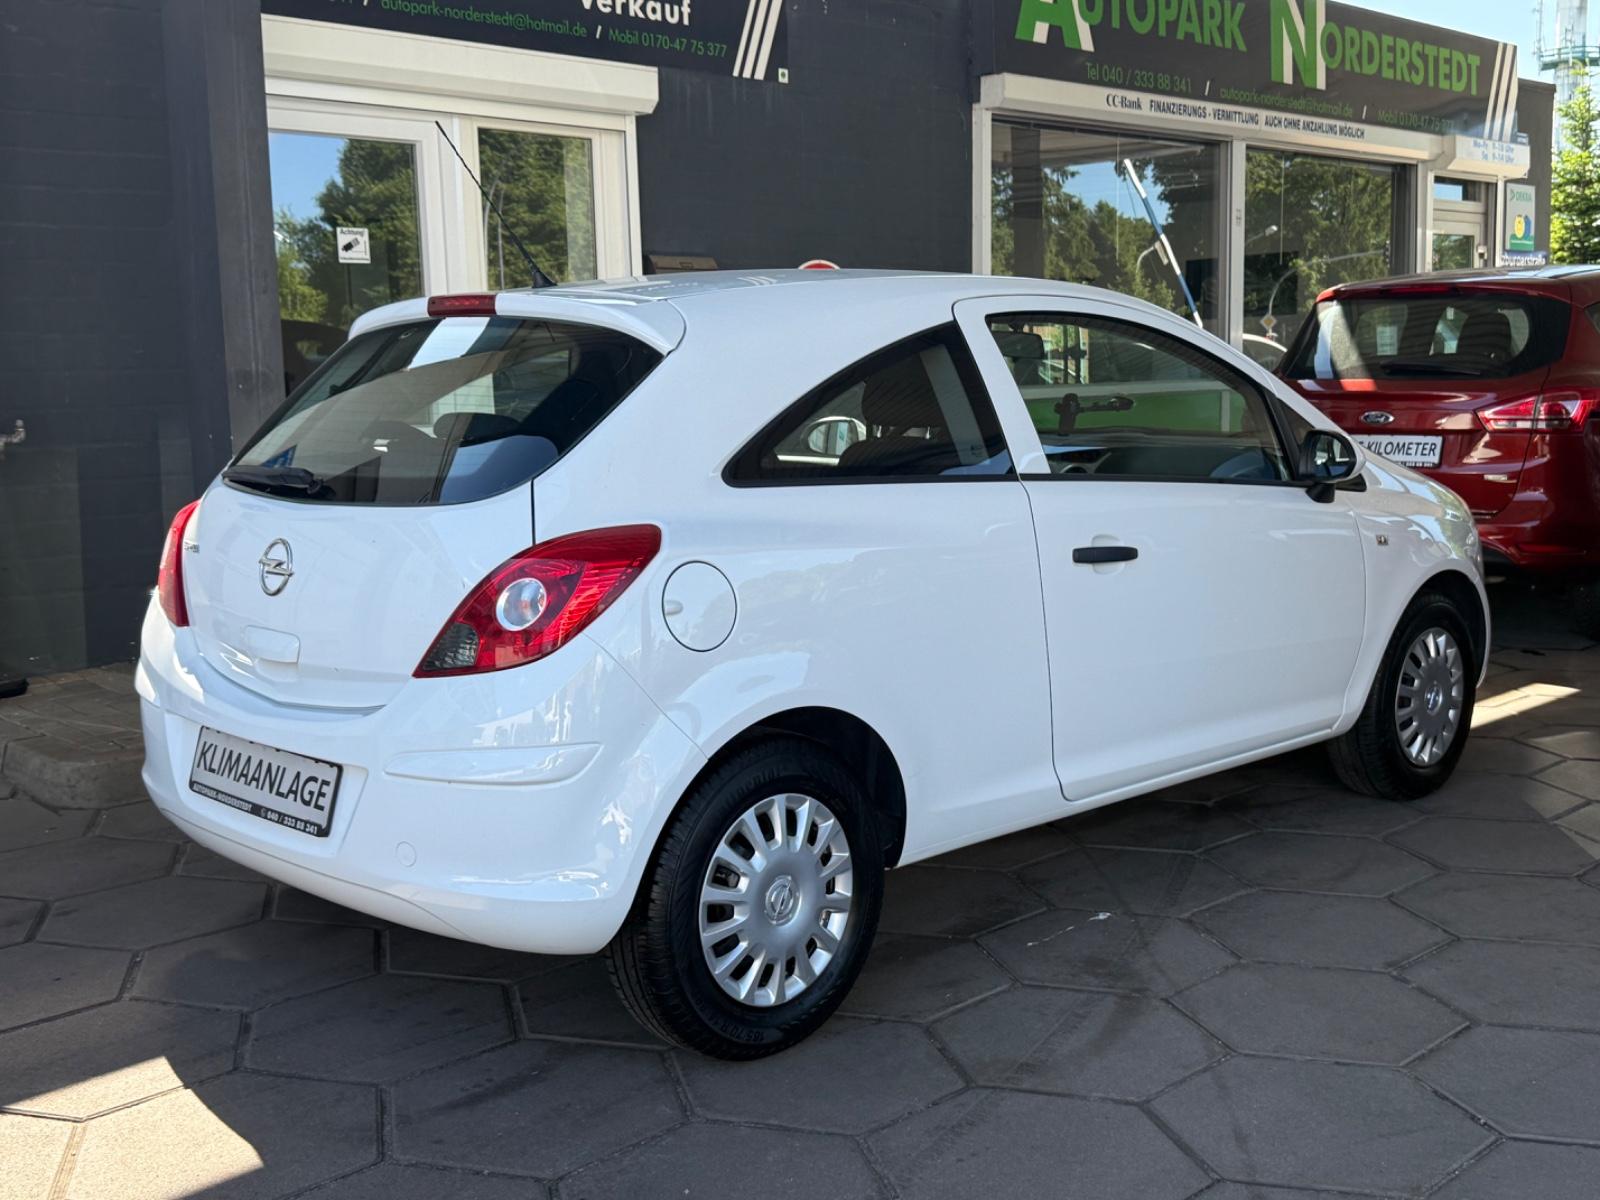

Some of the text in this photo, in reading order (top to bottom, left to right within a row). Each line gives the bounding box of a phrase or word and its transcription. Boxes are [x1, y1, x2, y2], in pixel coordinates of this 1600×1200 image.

[381, 0, 587, 38] autopark-norderstedt@hotmail.de
[608, 28, 641, 46] Mobil
[642, 32, 687, 52] 0170-47
[691, 40, 704, 55] 75
[708, 42, 728, 57] 377
[1015, 0, 1480, 96] AUTOPARK NORDERSTEDT
[1086, 62, 1099, 80] Tel
[1103, 65, 1123, 83] 040
[1134, 71, 1154, 88] 333
[1157, 75, 1170, 91] 88
[1174, 76, 1191, 93] 341
[1106, 93, 1142, 110] CC-Bank
[1150, 99, 1207, 119] FINANZIERUNGS
[1212, 108, 1259, 125] VERMITTLUNG
[1265, 115, 1282, 128] AUCH
[1283, 117, 1300, 130] OHNE
[1302, 119, 1338, 135] ANZAHLUNG
[1339, 122, 1365, 139] MÖGLICH
[1367, 441, 1437, 457] KILOMETER
[197, 741, 331, 812] KLIMAANLAGE
